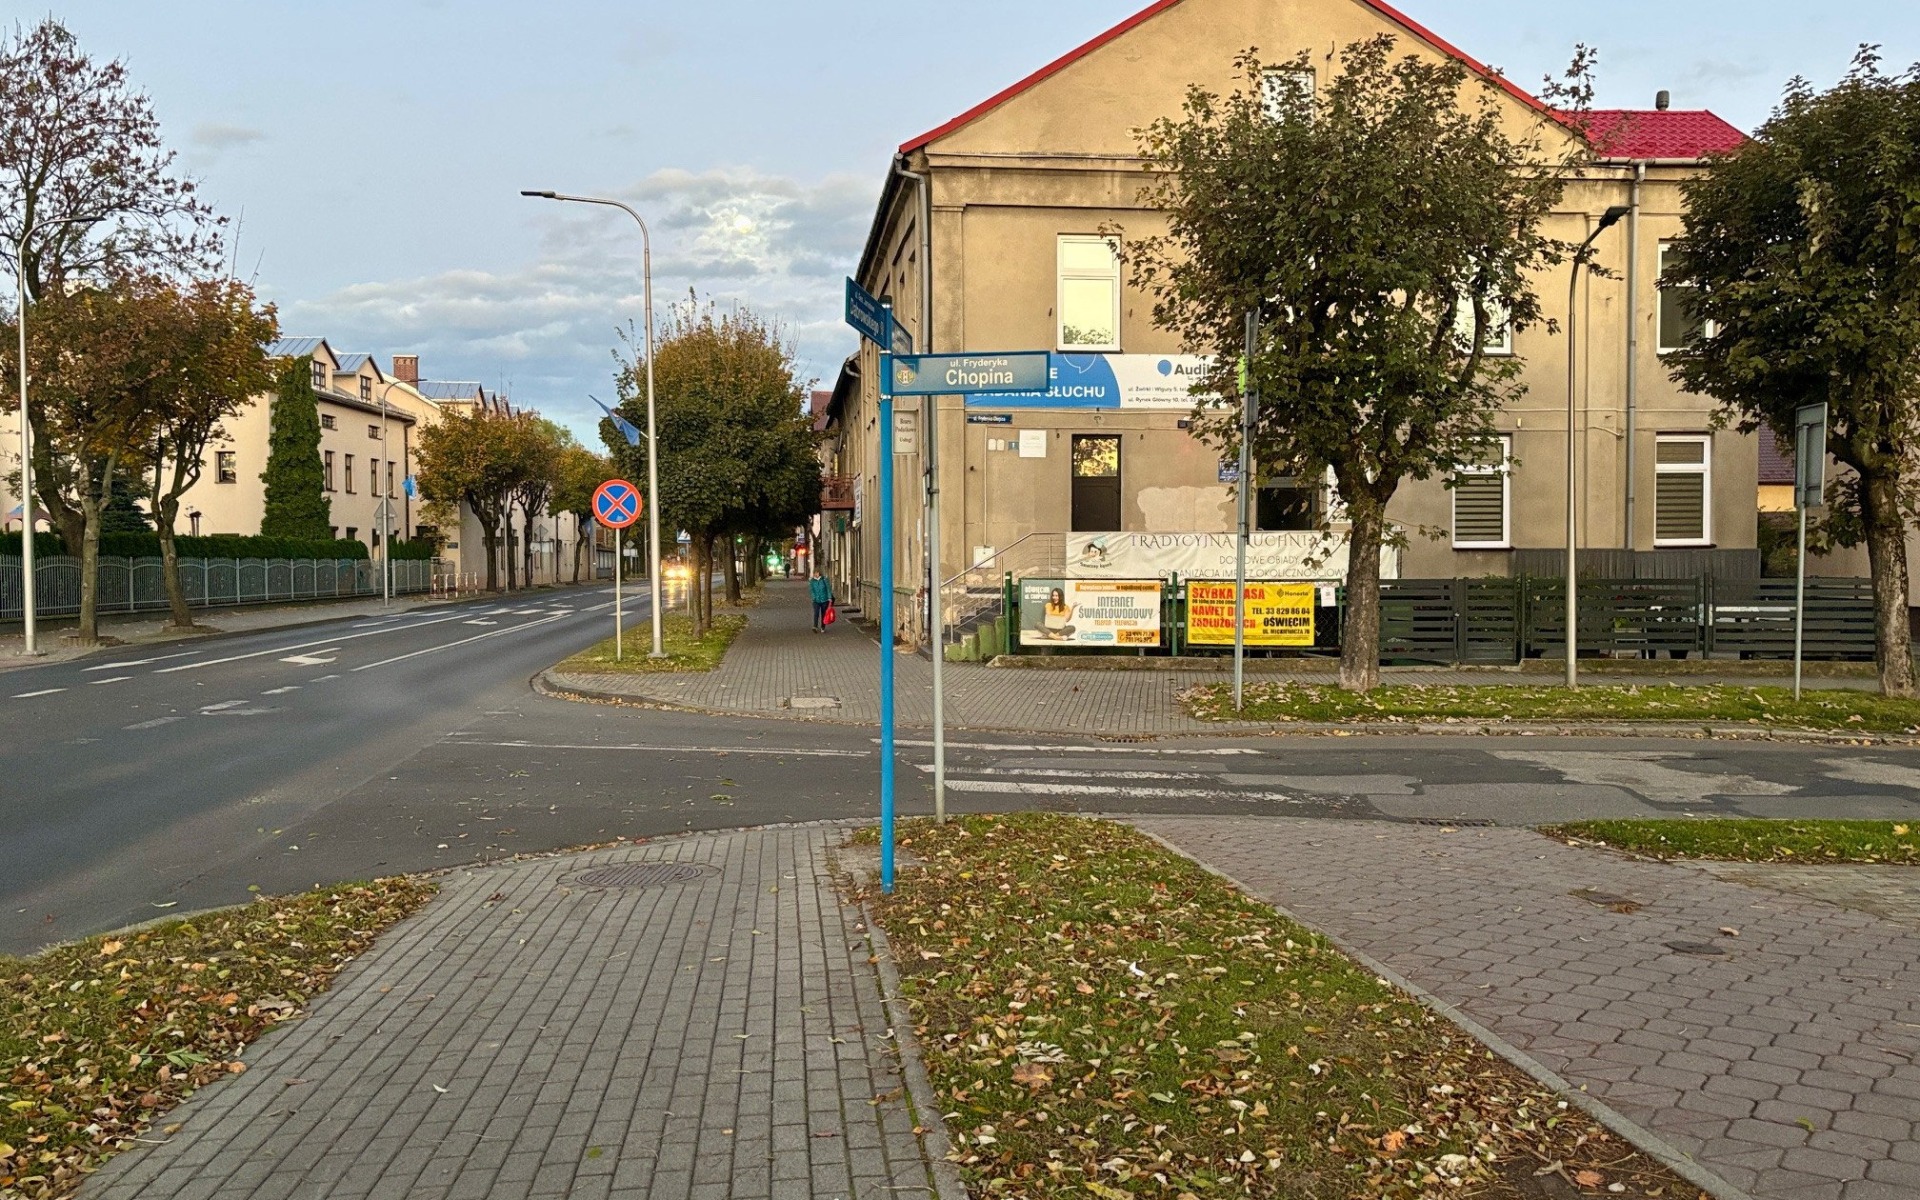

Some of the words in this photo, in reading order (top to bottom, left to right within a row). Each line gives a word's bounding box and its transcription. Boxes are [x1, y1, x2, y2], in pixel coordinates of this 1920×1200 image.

[950, 359, 961, 367] ul.
[963, 358, 1008, 369] Fryderyka
[946, 368, 1013, 389] Chopina
[1045, 386, 1105, 398] SŁUCHU
[1131, 532, 1235, 549] TRADYCYJNA
[1220, 556, 1264, 565] DOOWE
[1222, 569, 1253, 578] IMPEZ
[1192, 587, 1234, 599] SZYBKA
[1244, 588, 1265, 600] ASA
[1097, 597, 1134, 607] INTERNET
[1078, 605, 1153, 619] ŚWIATŁOWODOWY
[1192, 605, 1225, 616] NAWET
[1252, 607, 1264, 615] TEL.
[1265, 607, 1274, 615] 33
[1276, 607, 1289, 615] 829
[1191, 617, 1256, 628] ZADŁUŻONCH
[1263, 616, 1310, 628] OŚWIĘCIM
